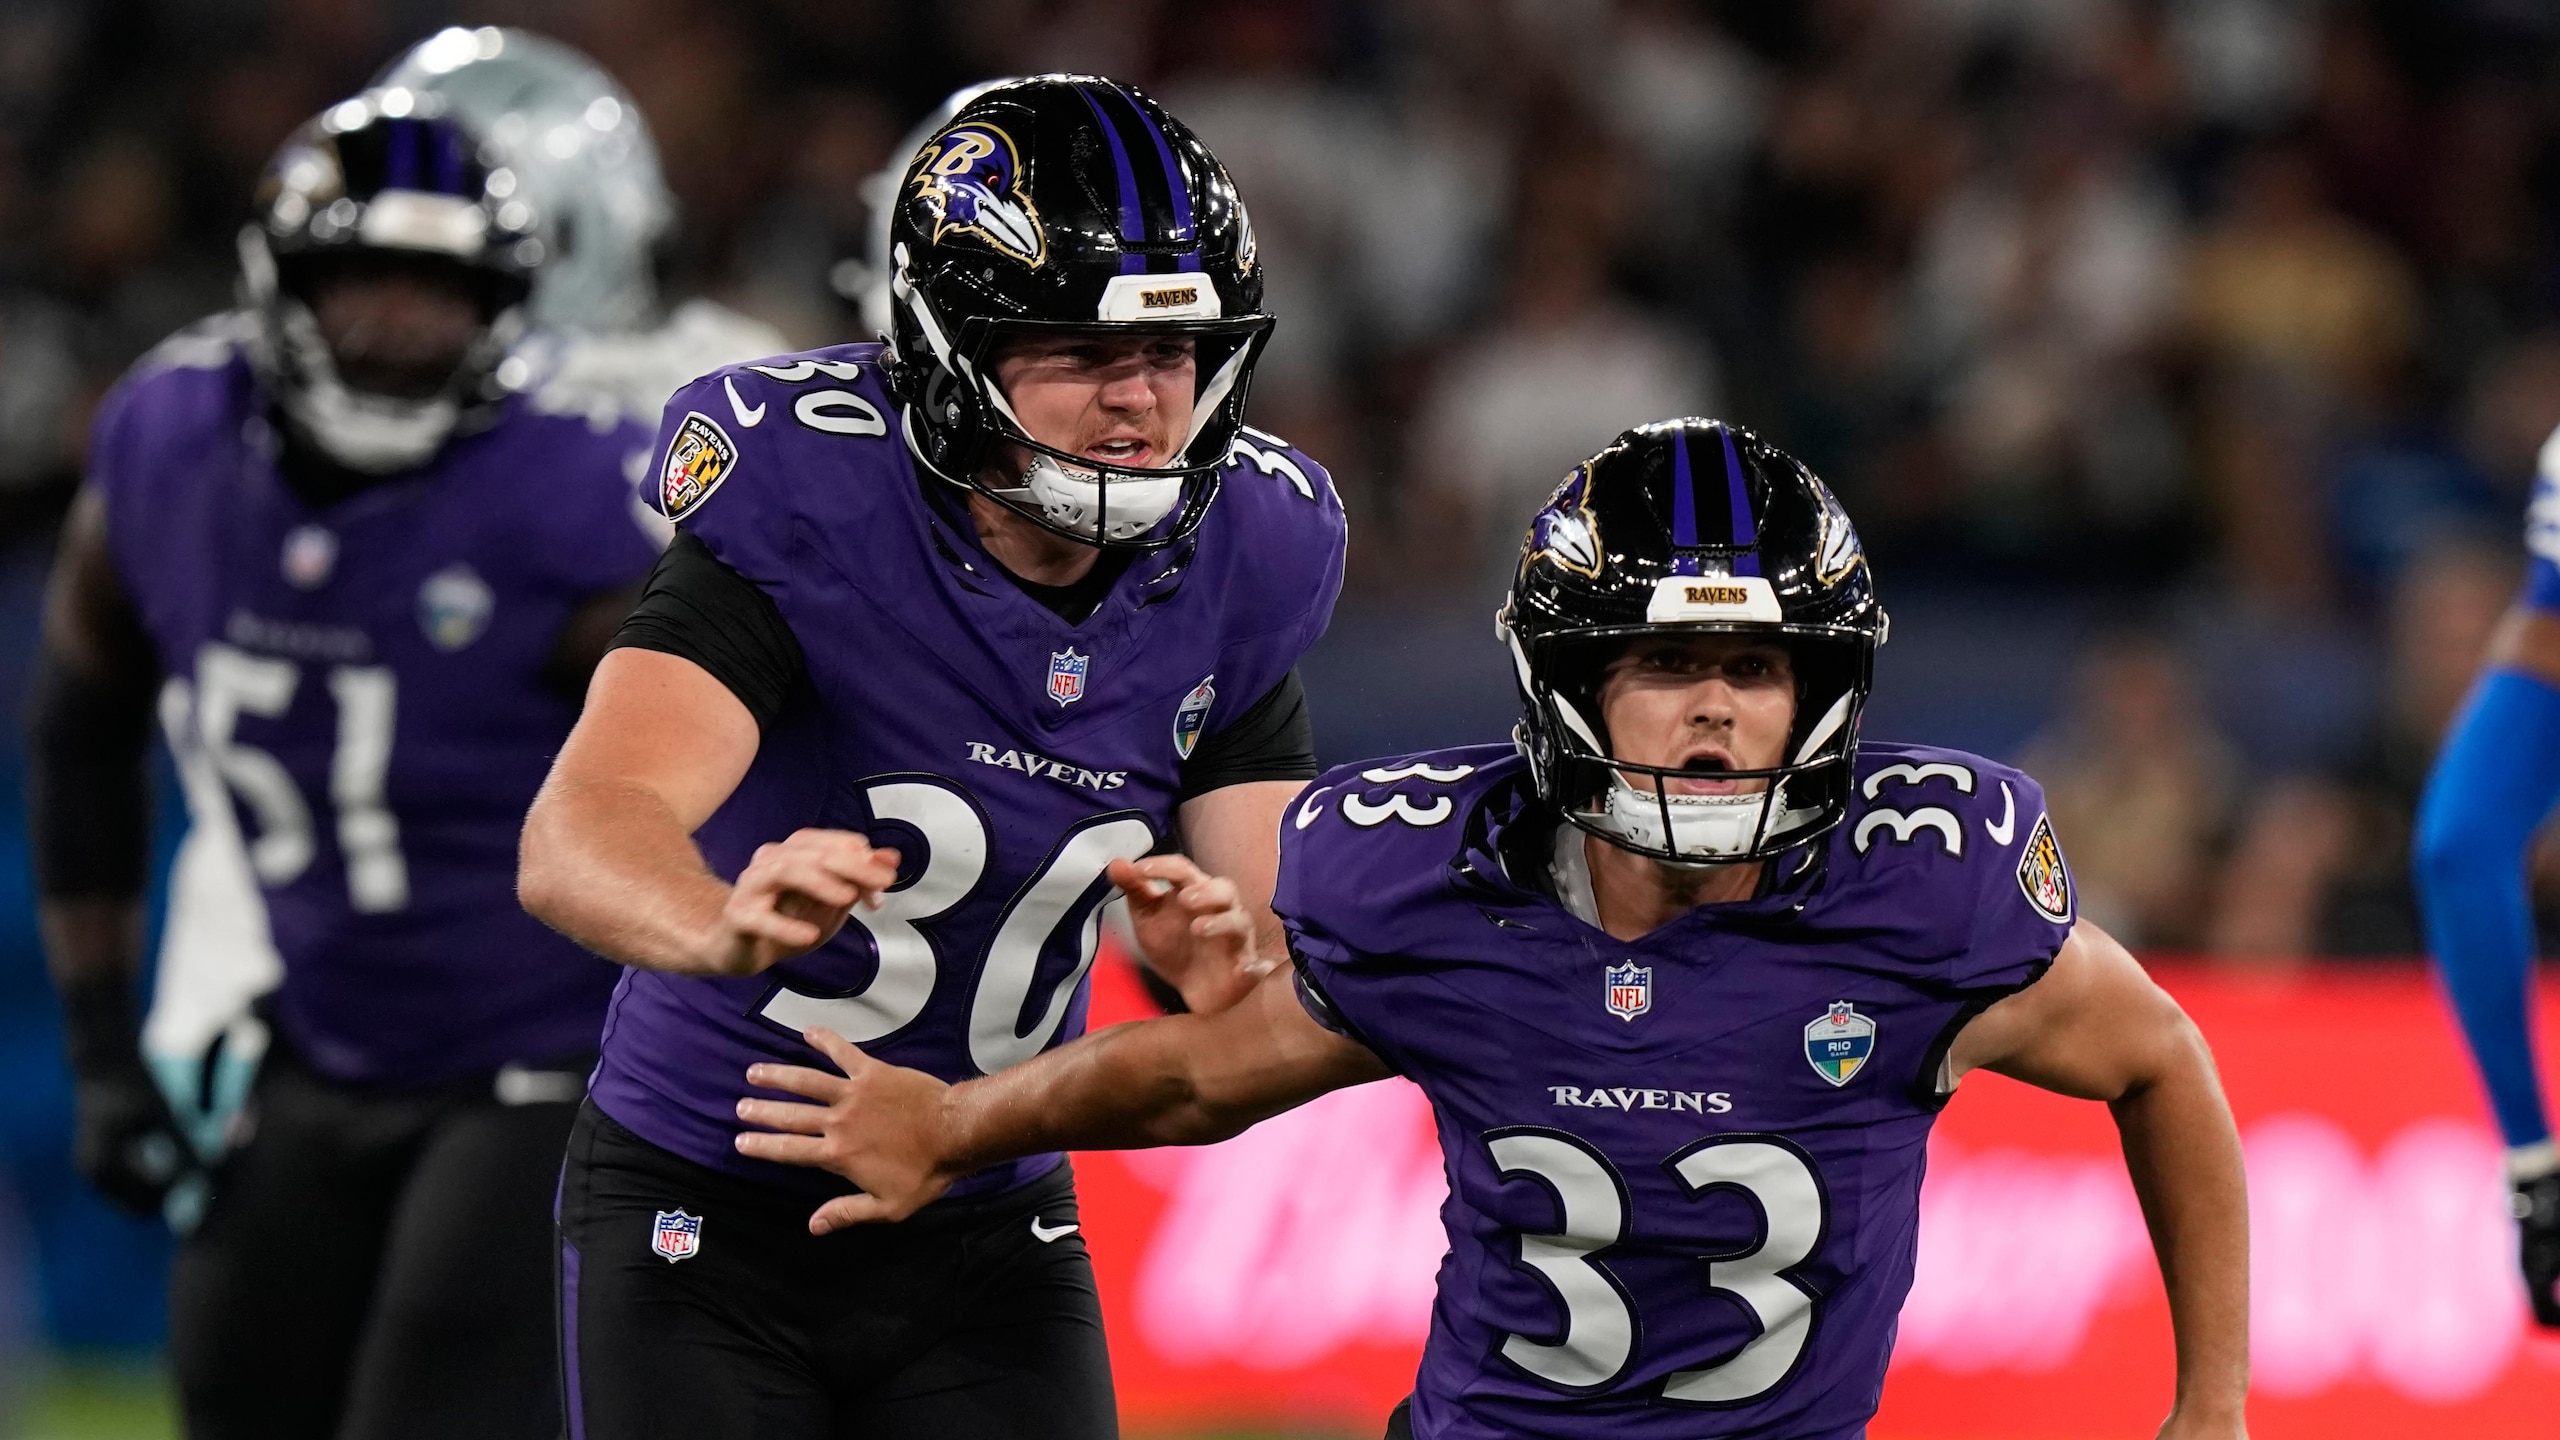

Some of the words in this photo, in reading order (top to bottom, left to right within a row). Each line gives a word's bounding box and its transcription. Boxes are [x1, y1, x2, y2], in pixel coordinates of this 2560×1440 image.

[930, 132, 996, 177] B
[1141, 287, 1198, 308] RAVENS
[747, 361, 887, 437] 30
[690, 420, 730, 461] RAVENS
[1226, 425, 1315, 499] 3
[1684, 586, 1748, 605] RAVENS
[1053, 674, 1079, 696] NFL
[196, 641, 412, 914] 51
[966, 742, 1127, 791] RAVENS
[1342, 762, 1475, 826] 33
[1854, 763, 1973, 855] 33
[760, 782, 1155, 1076] 30
[1612, 988, 1644, 1010] NFL
[1828, 1041, 1851, 1052] RIO
[1547, 1086, 1732, 1114] RAVENS
[660, 1231, 690, 1253] NFL
[1487, 1135, 1822, 1402] 33
